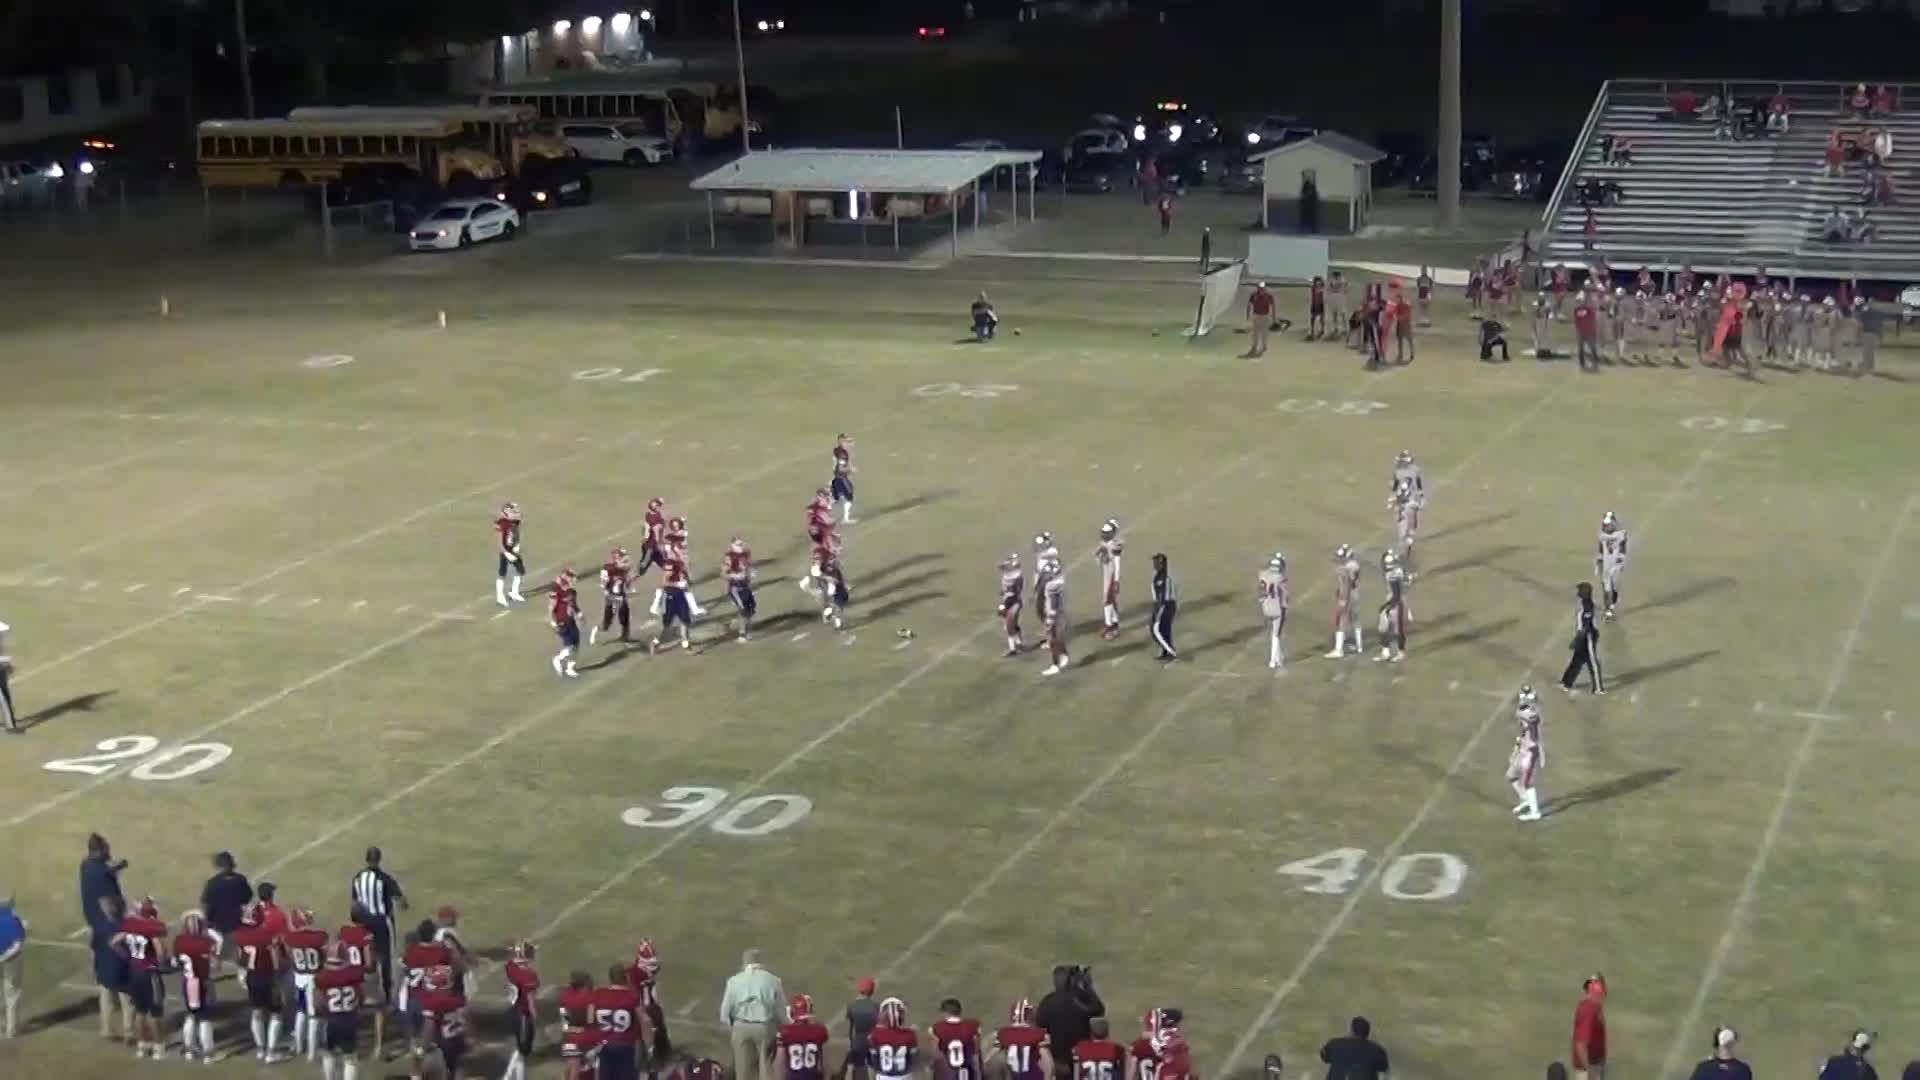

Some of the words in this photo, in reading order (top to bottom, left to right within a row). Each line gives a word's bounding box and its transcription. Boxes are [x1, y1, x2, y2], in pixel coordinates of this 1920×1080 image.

[42, 734, 232, 780] 20
[621, 786, 812, 834] 30
[1277, 847, 1468, 899] 40
[327, 986, 356, 1013] 22
[596, 1008, 631, 1033] 59
[788, 1043, 818, 1070] 86
[948, 1040, 965, 1067] 0
[1007, 1045, 1031, 1073] 41
